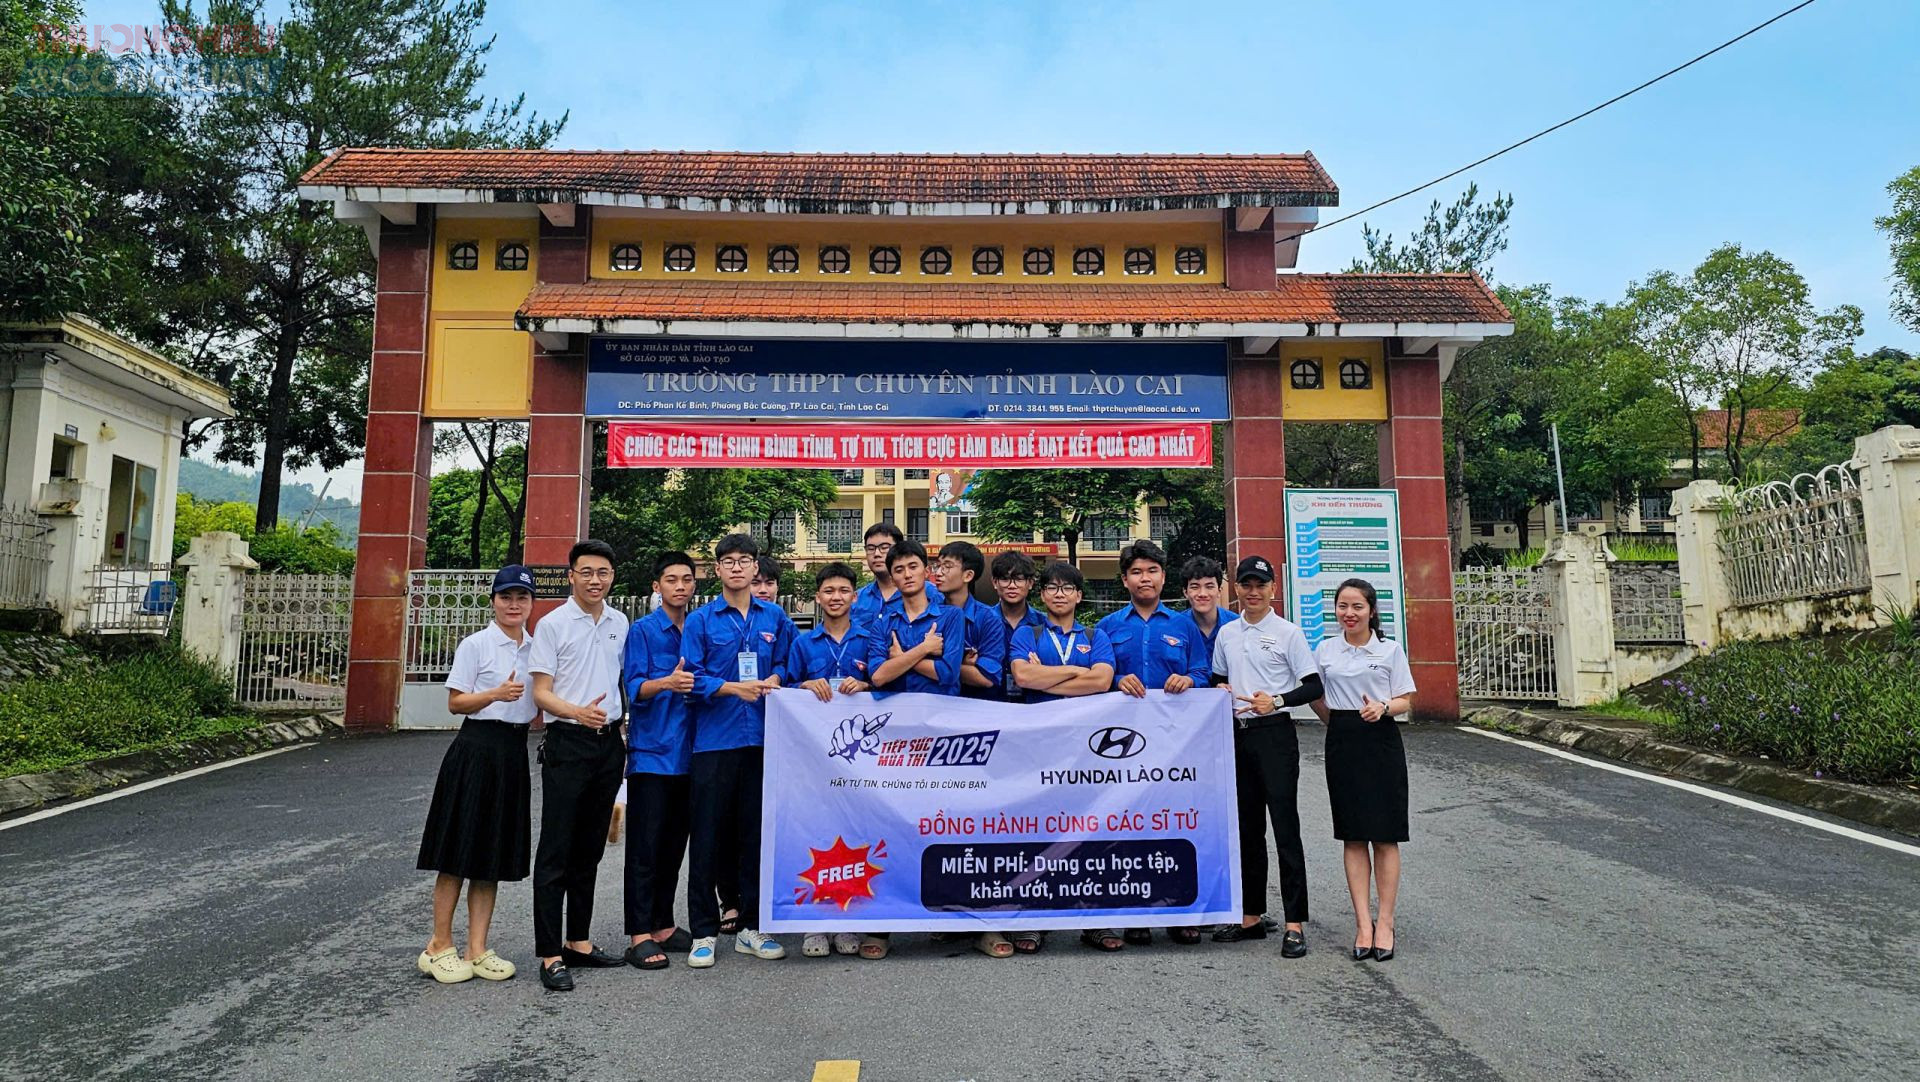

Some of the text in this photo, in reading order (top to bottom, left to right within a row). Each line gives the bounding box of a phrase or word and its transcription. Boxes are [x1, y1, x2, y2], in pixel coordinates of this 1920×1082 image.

[634, 353, 657, 362] GIÁO
[659, 355, 676, 364] DỤC
[679, 354, 689, 362] VÀ
[692, 354, 711, 362] ĐÀO
[713, 355, 730, 364] TẠO
[643, 343, 669, 351] NHÂN
[672, 343, 691, 351] DÂN
[719, 344, 736, 352] LÀO
[642, 366, 1183, 395] TRƯỜNG THPT CHUYÊN TỈNH LÀO CAI
[653, 401, 674, 409] Phan
[790, 402, 802, 410] TP.
[821, 402, 836, 411] Cai,
[875, 403, 889, 411] Cai
[1049, 404, 1064, 412] 955
[624, 433, 664, 457] CHÚC
[667, 433, 697, 457] CÁC
[700, 433, 723, 458] THÍ
[727, 436, 760, 458] SINH
[764, 433, 798, 458] BÌNH
[801, 433, 837, 460] TĨNH,
[840, 433, 860, 462] TỰ
[862, 436, 888, 460] TIN,
[891, 433, 923, 458] TÍCH
[927, 433, 955, 462] CỰC
[959, 433, 987, 458] LÀM
[991, 433, 1014, 458] BÀI
[1039, 436, 1065, 461] ĐẠT
[1069, 429, 1093, 457] KẾT
[1097, 431, 1125, 460] QUẢ
[1128, 435, 1156, 457] CAO
[1159, 429, 1195, 457] NHẤT
[930, 735, 995, 766] 2025
[830, 777, 847, 788] HÃY
[881, 779, 912, 789] CHÚNG
[930, 780, 940, 789] ĐI
[941, 779, 966, 789] CÙNG
[968, 780, 987, 791] BẠN
[1041, 765, 1196, 785] HYUNDAI LÀO CAI
[919, 808, 1199, 835] ĐỒNG HÀNH CÙNG CÁC SĨ TỬ
[817, 861, 865, 885] FREE
[942, 848, 1179, 876] MIỄN PHÍ: Dụng cụ học tập,
[971, 873, 1151, 900] khăn ướt, nước uống
